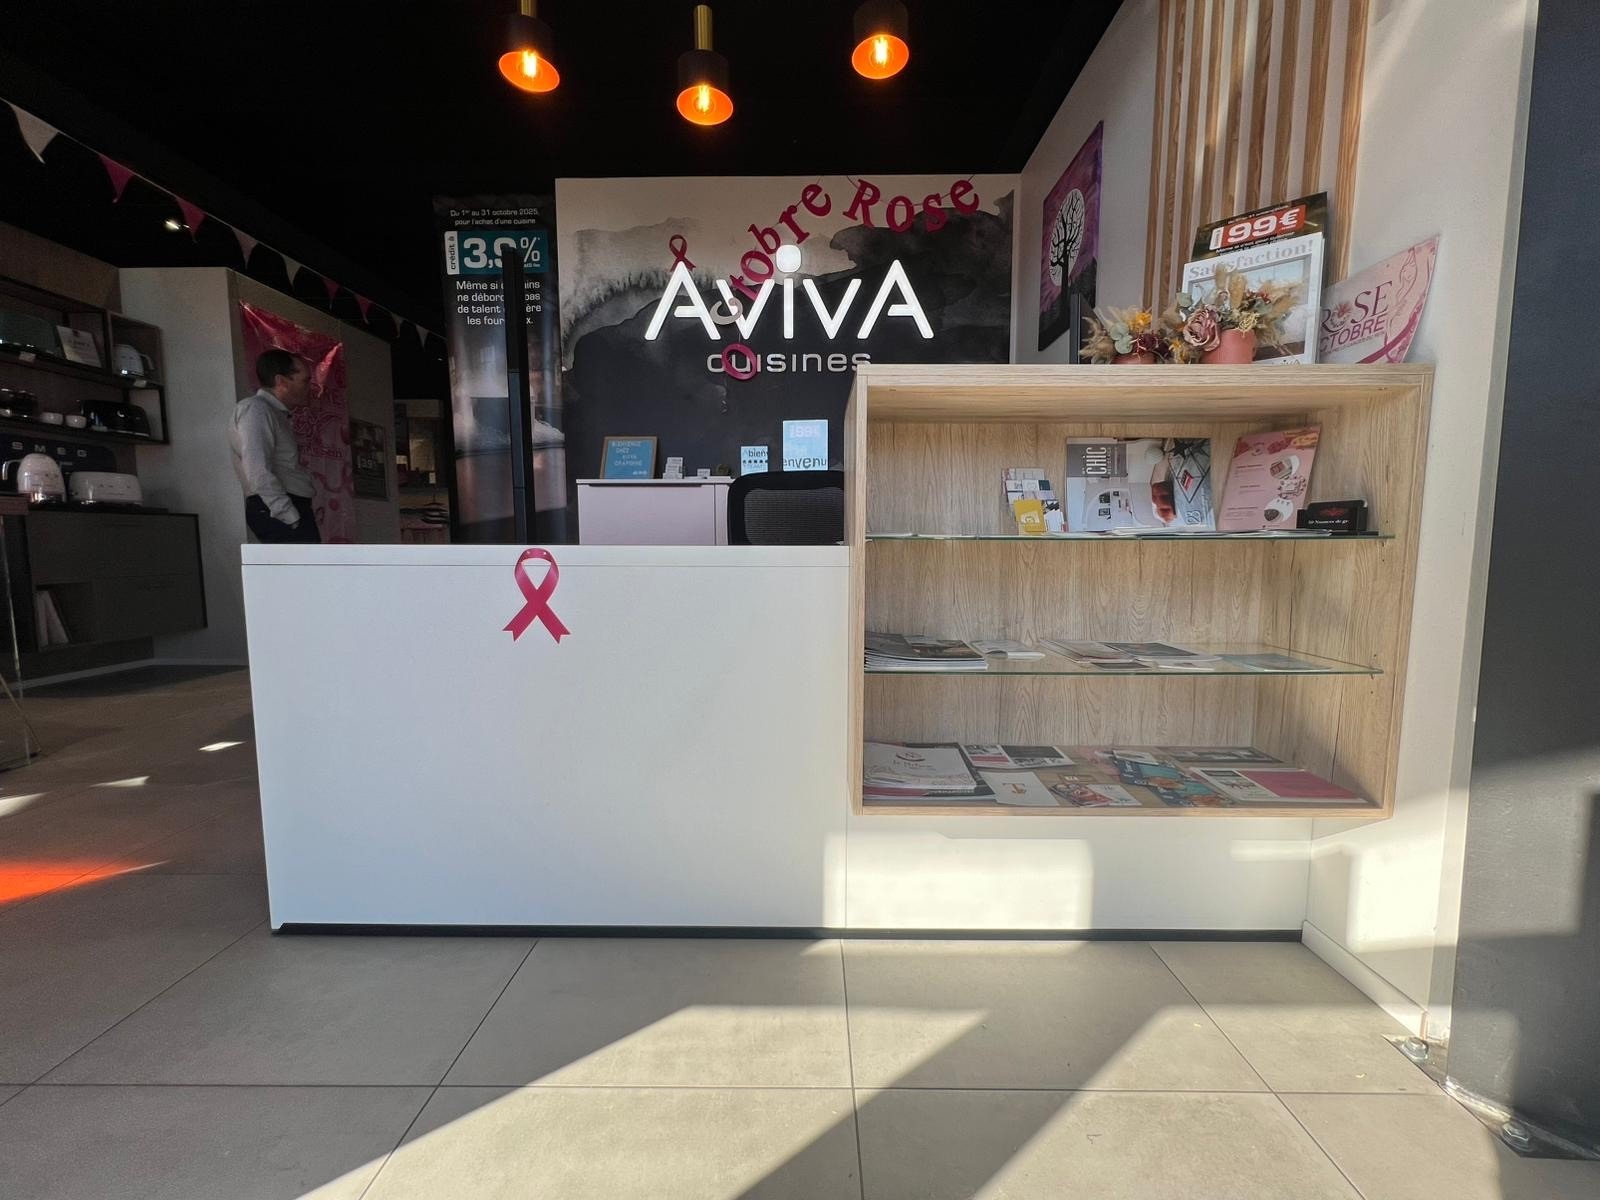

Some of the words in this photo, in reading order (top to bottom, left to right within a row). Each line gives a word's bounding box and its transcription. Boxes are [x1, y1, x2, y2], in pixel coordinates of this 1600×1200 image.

[842, 179, 980, 233] Rose
[481, 208, 490, 216] 31
[492, 208, 518, 216] octobre
[513, 217, 536, 225] cuisine
[1226, 208, 1301, 243] 99€
[1188, 239, 1314, 279] Satfaction!
[456, 280, 488, 290] Même
[490, 280, 498, 290] si
[457, 294, 469, 302] ne
[457, 305, 469, 313] de
[472, 305, 501, 314] talent
[467, 316, 481, 325] les
[1320, 313, 1388, 352] CTOBRE
[11, 441, 88, 458] SMEG
